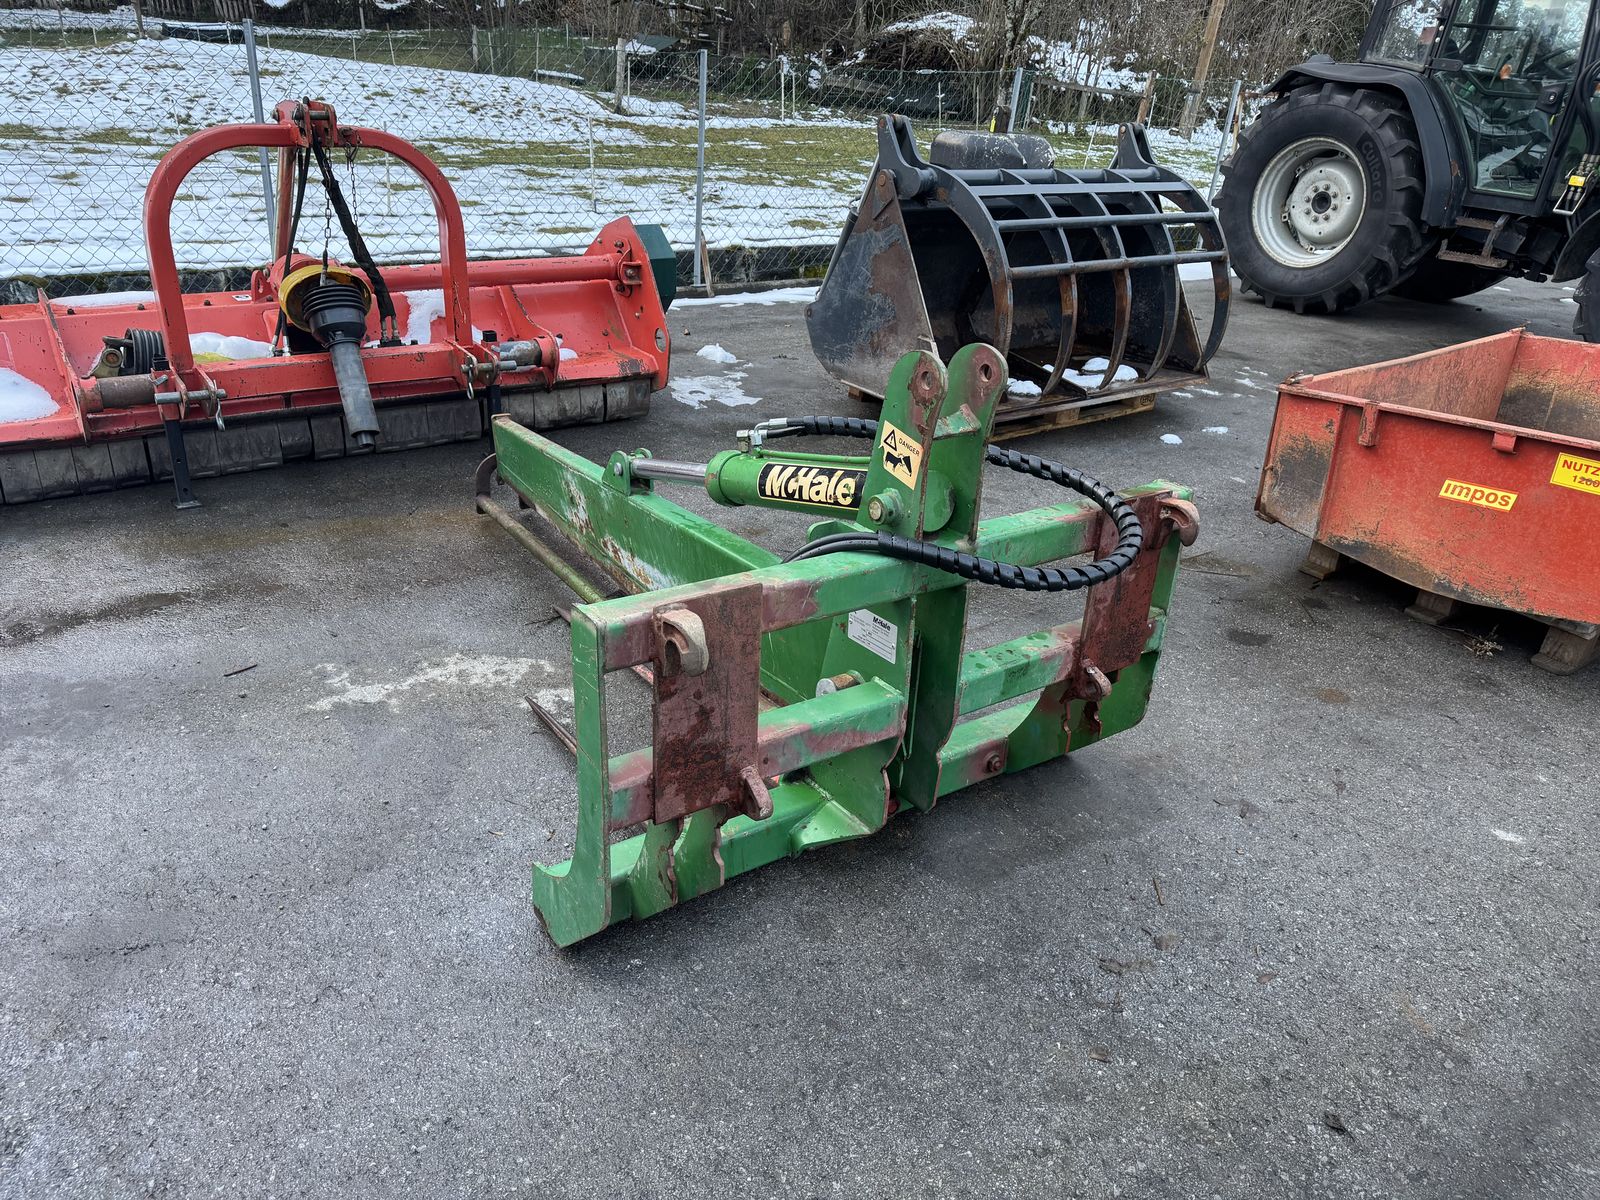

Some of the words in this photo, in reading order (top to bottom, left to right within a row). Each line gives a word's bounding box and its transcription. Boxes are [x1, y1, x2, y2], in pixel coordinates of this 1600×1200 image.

[899, 437, 921, 457] DANGER
[765, 465, 856, 505] McHale
[1443, 483, 1512, 507] impos
